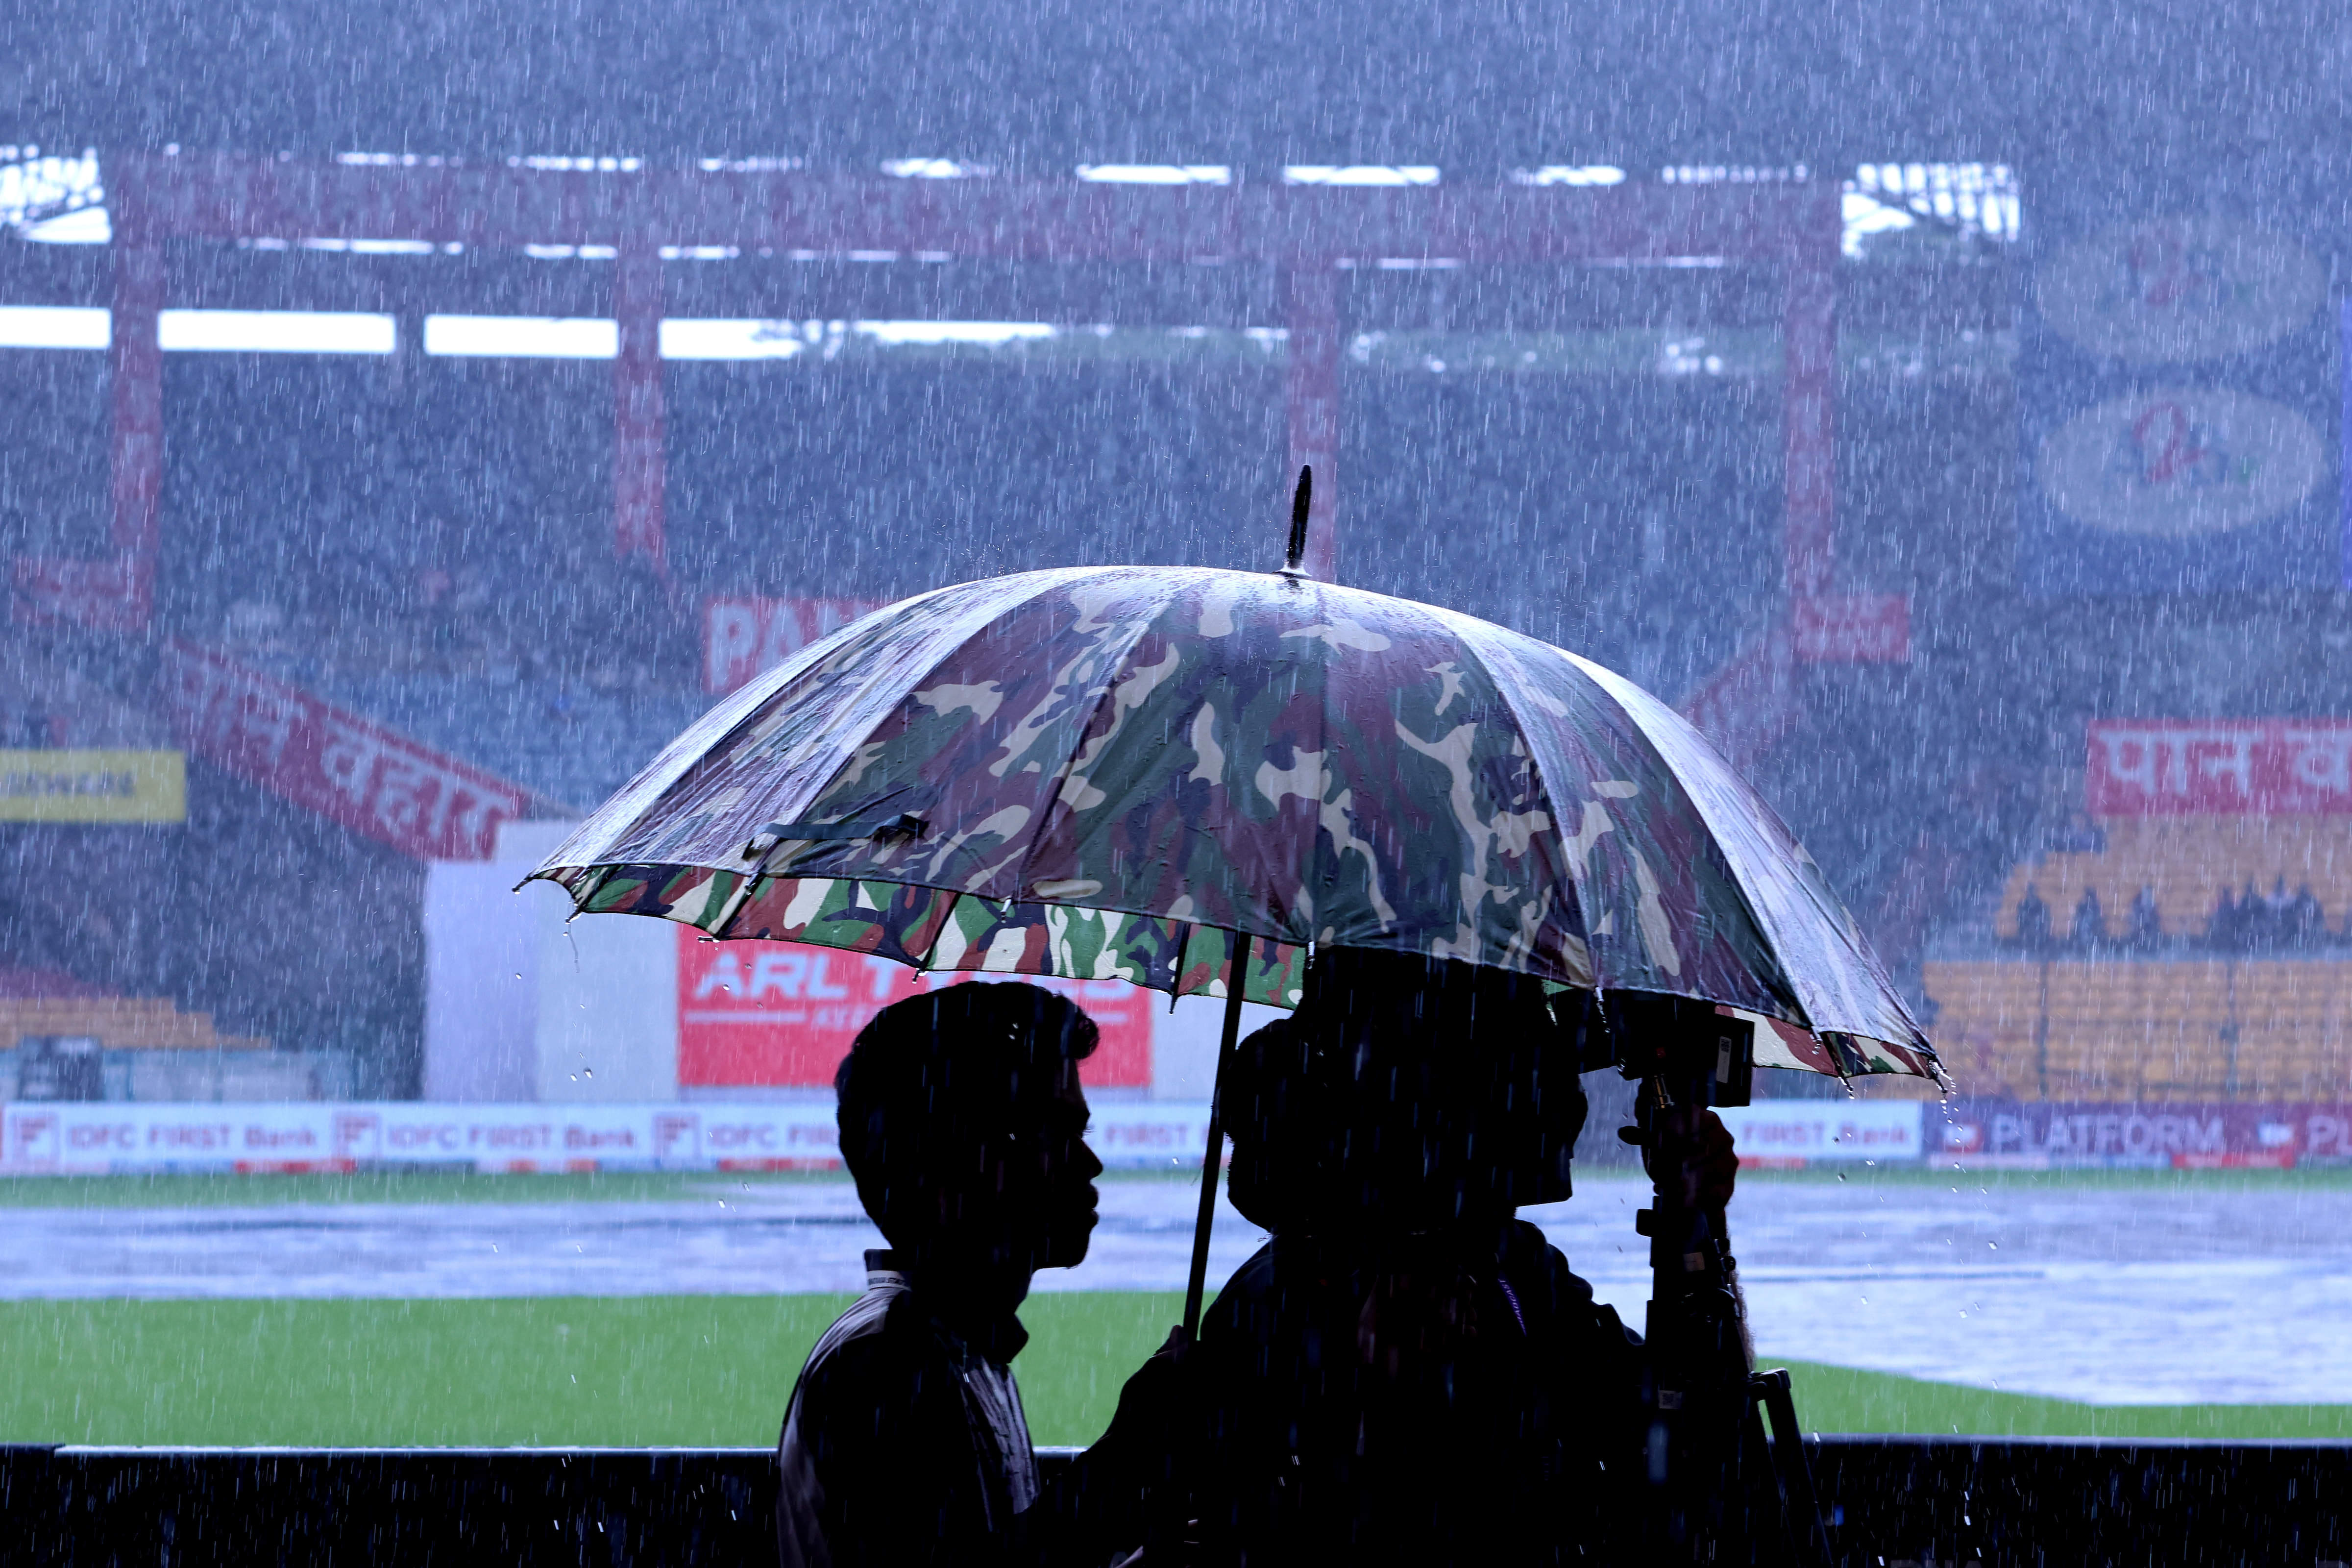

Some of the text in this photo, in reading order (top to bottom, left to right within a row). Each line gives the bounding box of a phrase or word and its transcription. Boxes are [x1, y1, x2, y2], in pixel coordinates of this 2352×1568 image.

[2099, 729, 2265, 796] पान
[695, 952, 847, 999] ARL
[68, 1123, 137, 1150] IDFC
[148, 1123, 230, 1149] FIRST
[245, 1123, 317, 1149] Bank
[388, 1123, 460, 1150] IDFC
[468, 1123, 551, 1149] FIRST
[564, 1123, 635, 1149] Bank
[707, 1123, 777, 1149] IDFC
[1104, 1124, 1188, 1147] FIRST
[1742, 1121, 1909, 1145] FIRST Bank
[1990, 1113, 2225, 1154] PLATFORM
